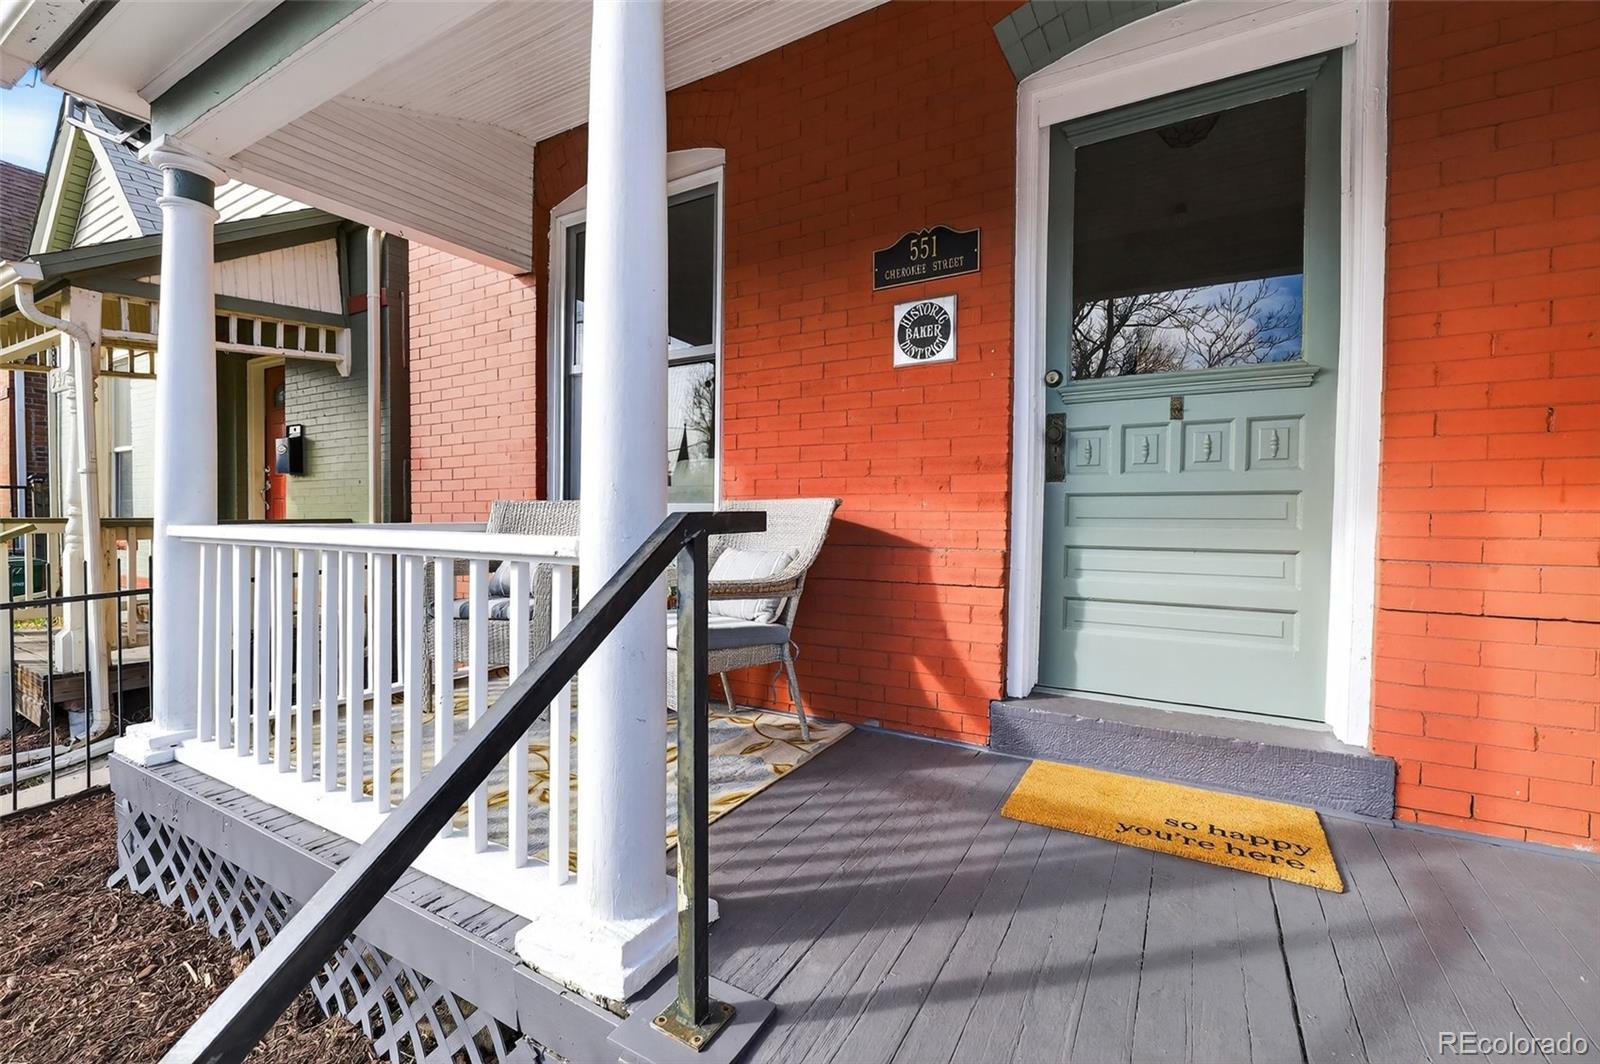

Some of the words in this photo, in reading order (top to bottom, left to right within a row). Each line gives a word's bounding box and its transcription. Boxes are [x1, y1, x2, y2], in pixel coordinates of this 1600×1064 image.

[909, 235, 938, 261] 551
[884, 263, 927, 280] CHEROKEE
[932, 256, 965, 272] STREET
[900, 303, 949, 328] HISTORIC
[905, 324, 942, 340] BAKER
[900, 337, 947, 359] DISTRICT
[1115, 821, 1215, 851] you're
[1225, 842, 1317, 873] here.
[1164, 817, 1198, 831] so
[1208, 823, 1312, 856] happy
